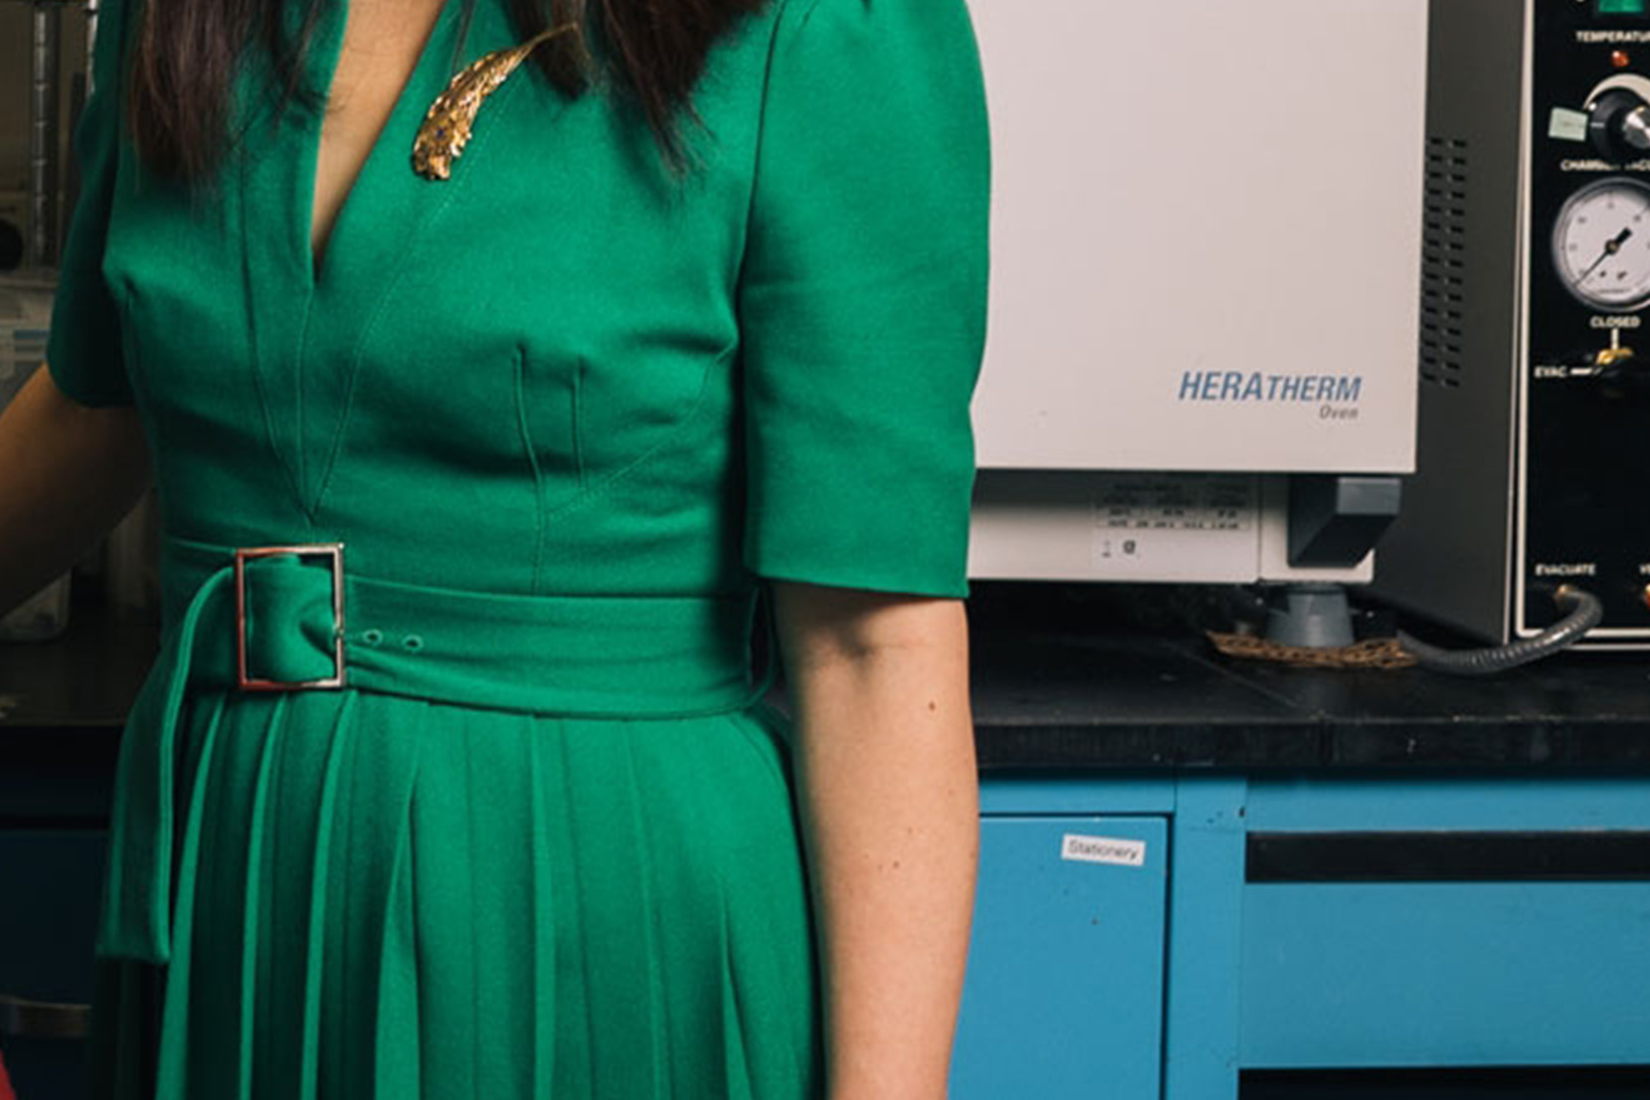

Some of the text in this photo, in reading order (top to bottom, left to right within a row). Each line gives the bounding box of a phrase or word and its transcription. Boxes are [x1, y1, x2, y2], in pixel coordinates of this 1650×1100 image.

[1590, 315, 1641, 328] CLOSED
[1178, 371, 1362, 402] HERATHERM
[1319, 404, 1359, 420] Oven
[1535, 563, 1596, 577] EVACUATE
[1068, 839, 1139, 861] Stationery
